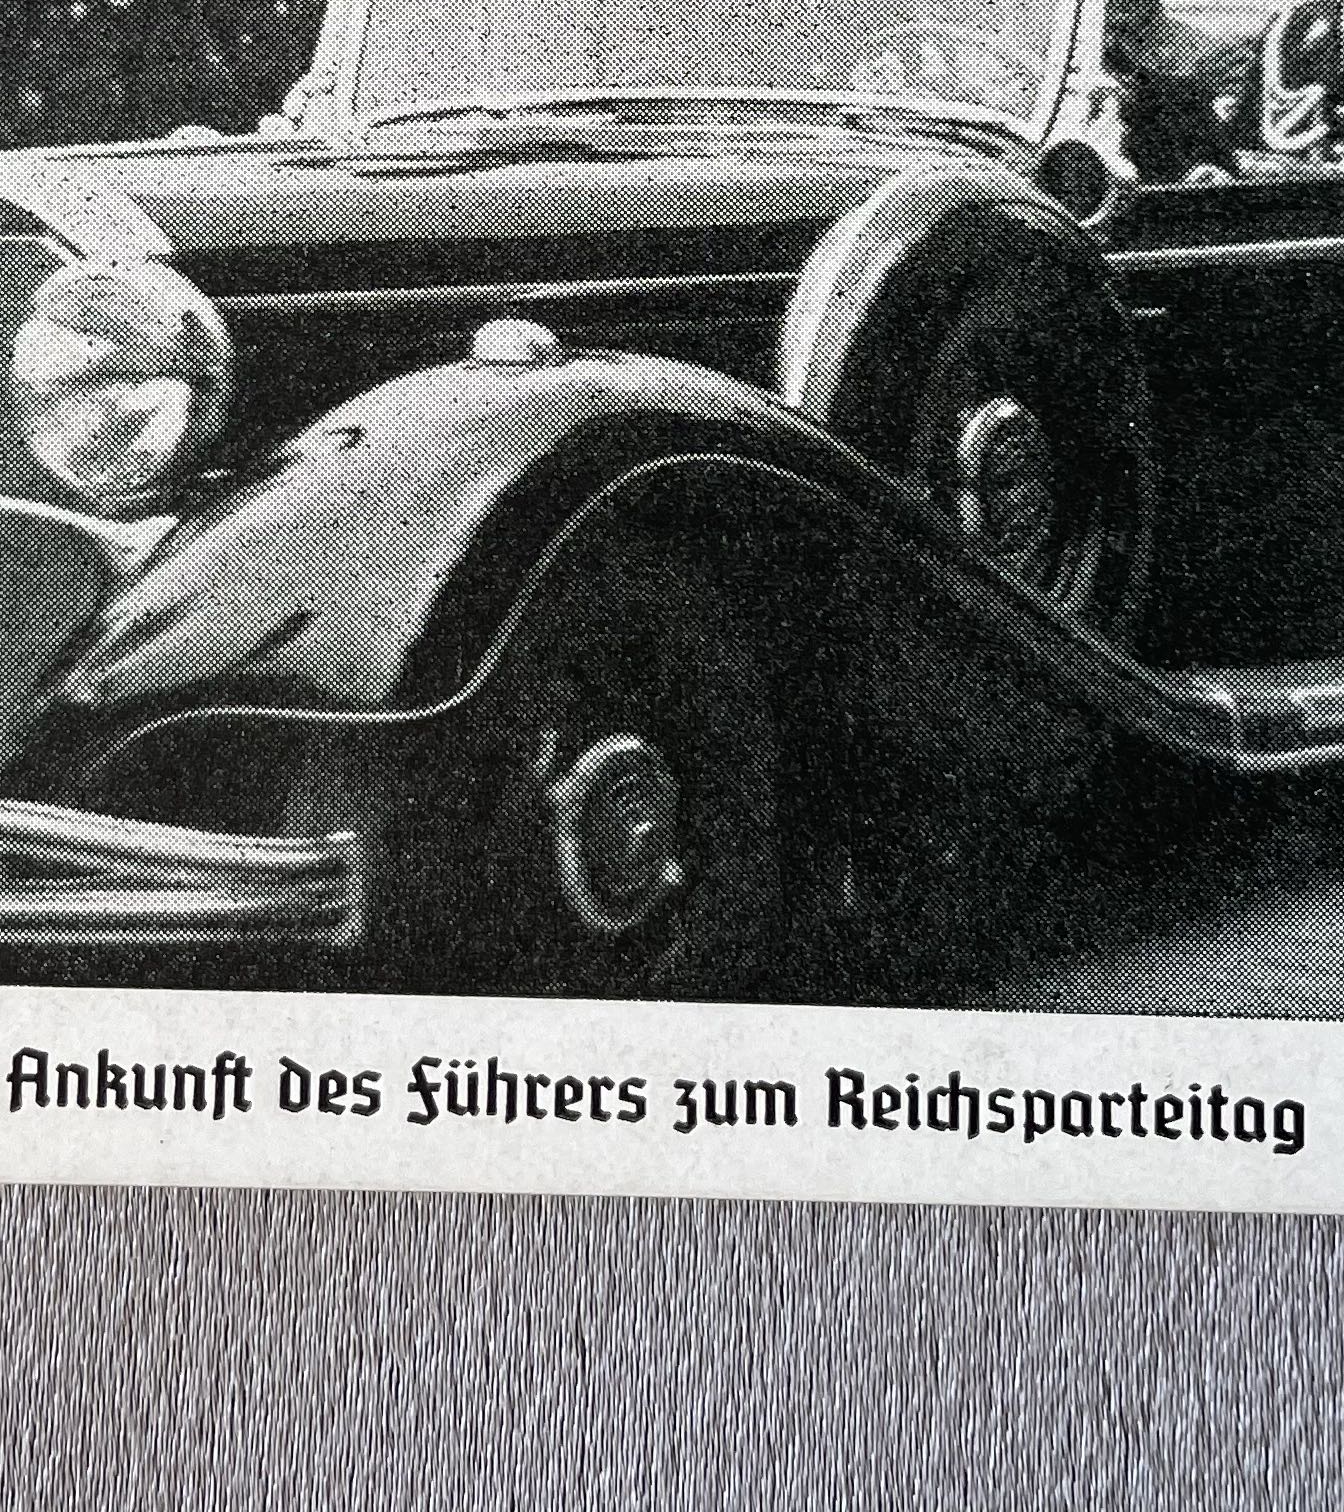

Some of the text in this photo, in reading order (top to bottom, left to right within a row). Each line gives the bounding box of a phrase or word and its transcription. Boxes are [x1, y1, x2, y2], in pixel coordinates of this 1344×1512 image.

[5, 1046, 253, 1121] Ankunft
[277, 1054, 381, 1117] des
[405, 1055, 647, 1126] Führers
[672, 1078, 798, 1134] zum
[823, 1066, 1305, 1156] Reichsparteitag
